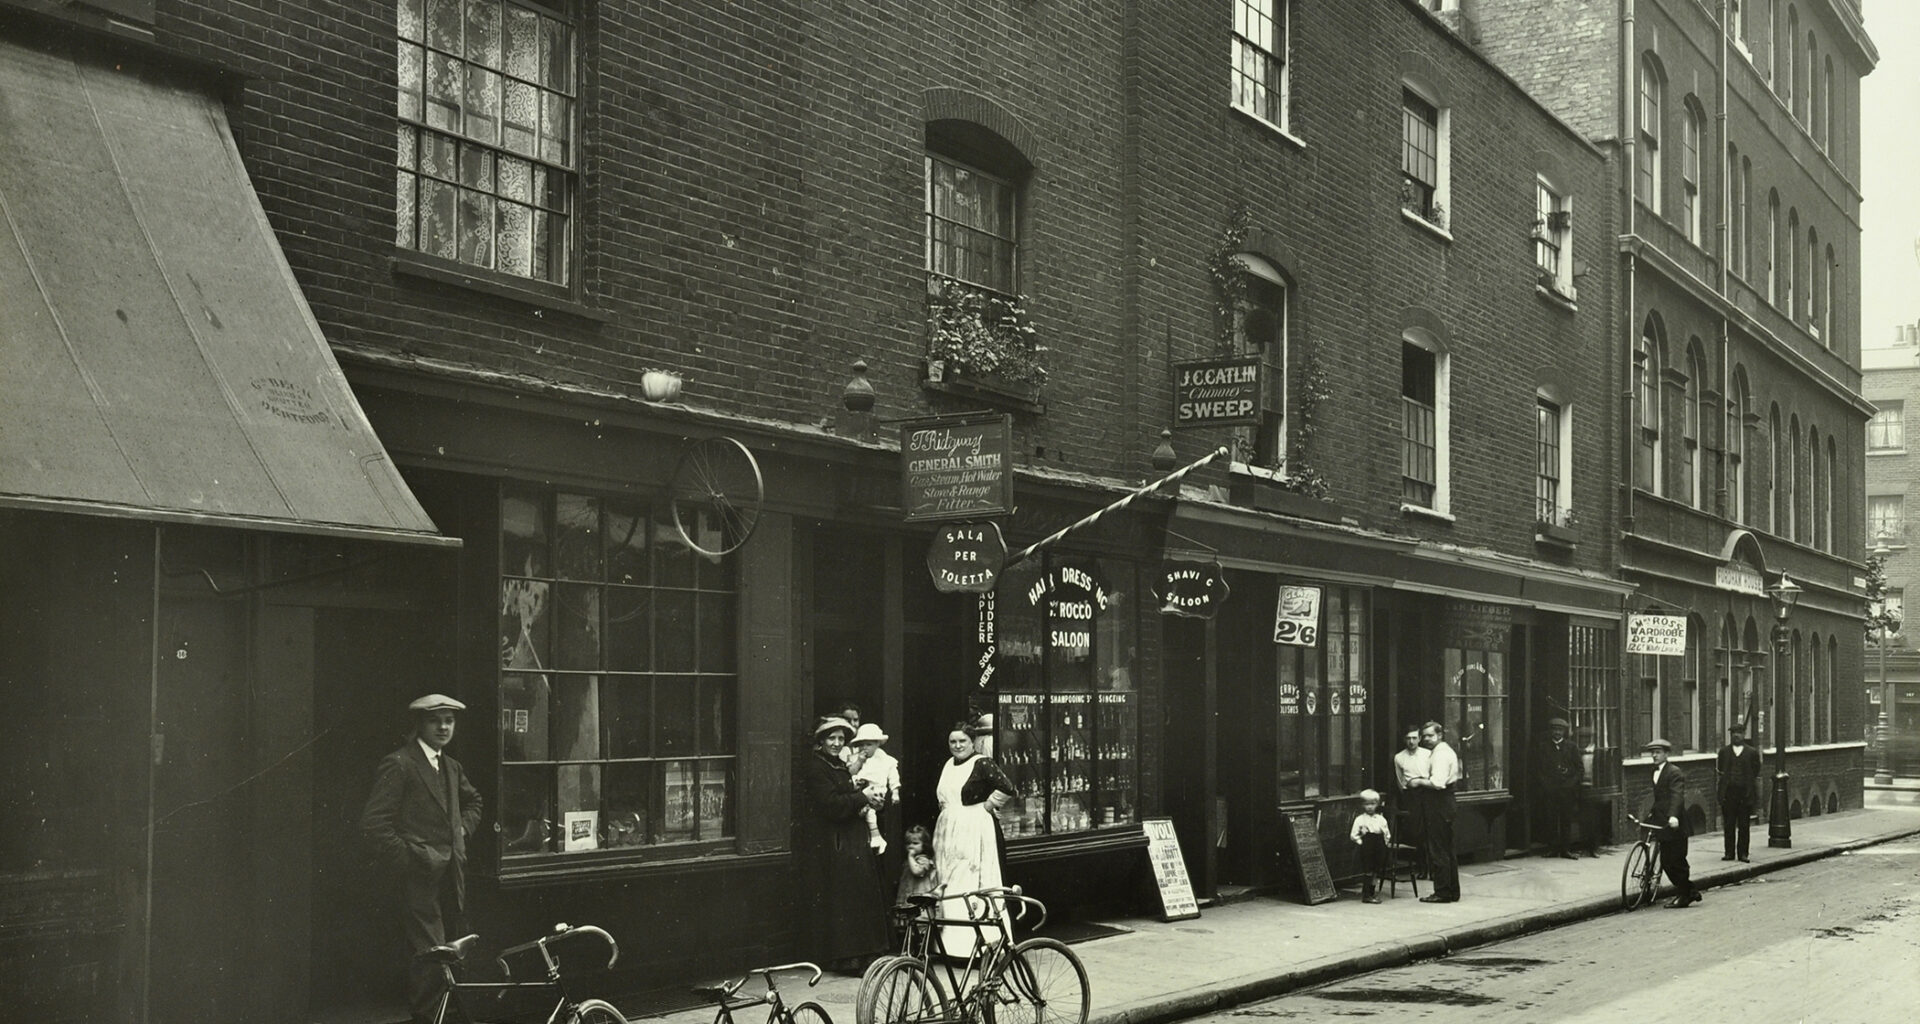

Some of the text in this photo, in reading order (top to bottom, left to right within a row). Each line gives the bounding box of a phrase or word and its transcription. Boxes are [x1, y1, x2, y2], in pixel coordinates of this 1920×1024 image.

[1189, 386, 1241, 400] Chimney
[1179, 399, 1254, 419] SWEEP.
[909, 453, 1001, 472] GENERAL SMITH
[923, 485, 991, 500] Stove & Range
[946, 530, 983, 543] SALA
[954, 551, 977, 561] PER
[941, 568, 994, 585] TOLETTA
[1166, 592, 1210, 607] SALOON
[978, 592, 986, 643] APIER
[986, 590, 995, 644] OUDRE
[1059, 602, 1092, 620] ROCCO
[1652, 616, 1683, 630] ROSS
[1051, 631, 1090, 647] SALOON
[1276, 621, 1315, 644] 2'6
[1630, 627, 1684, 637] WARDROBE
[1632, 635, 1677, 644] DEALER
[978, 645, 996, 669] SOLD
[978, 663, 996, 688] HERE
[998, 694, 1012, 704] HAIR
[1014, 694, 1037, 704] CUTTING
[1280, 684, 1300, 700] ERRY'S
[1349, 684, 1367, 700] ERRY'S
